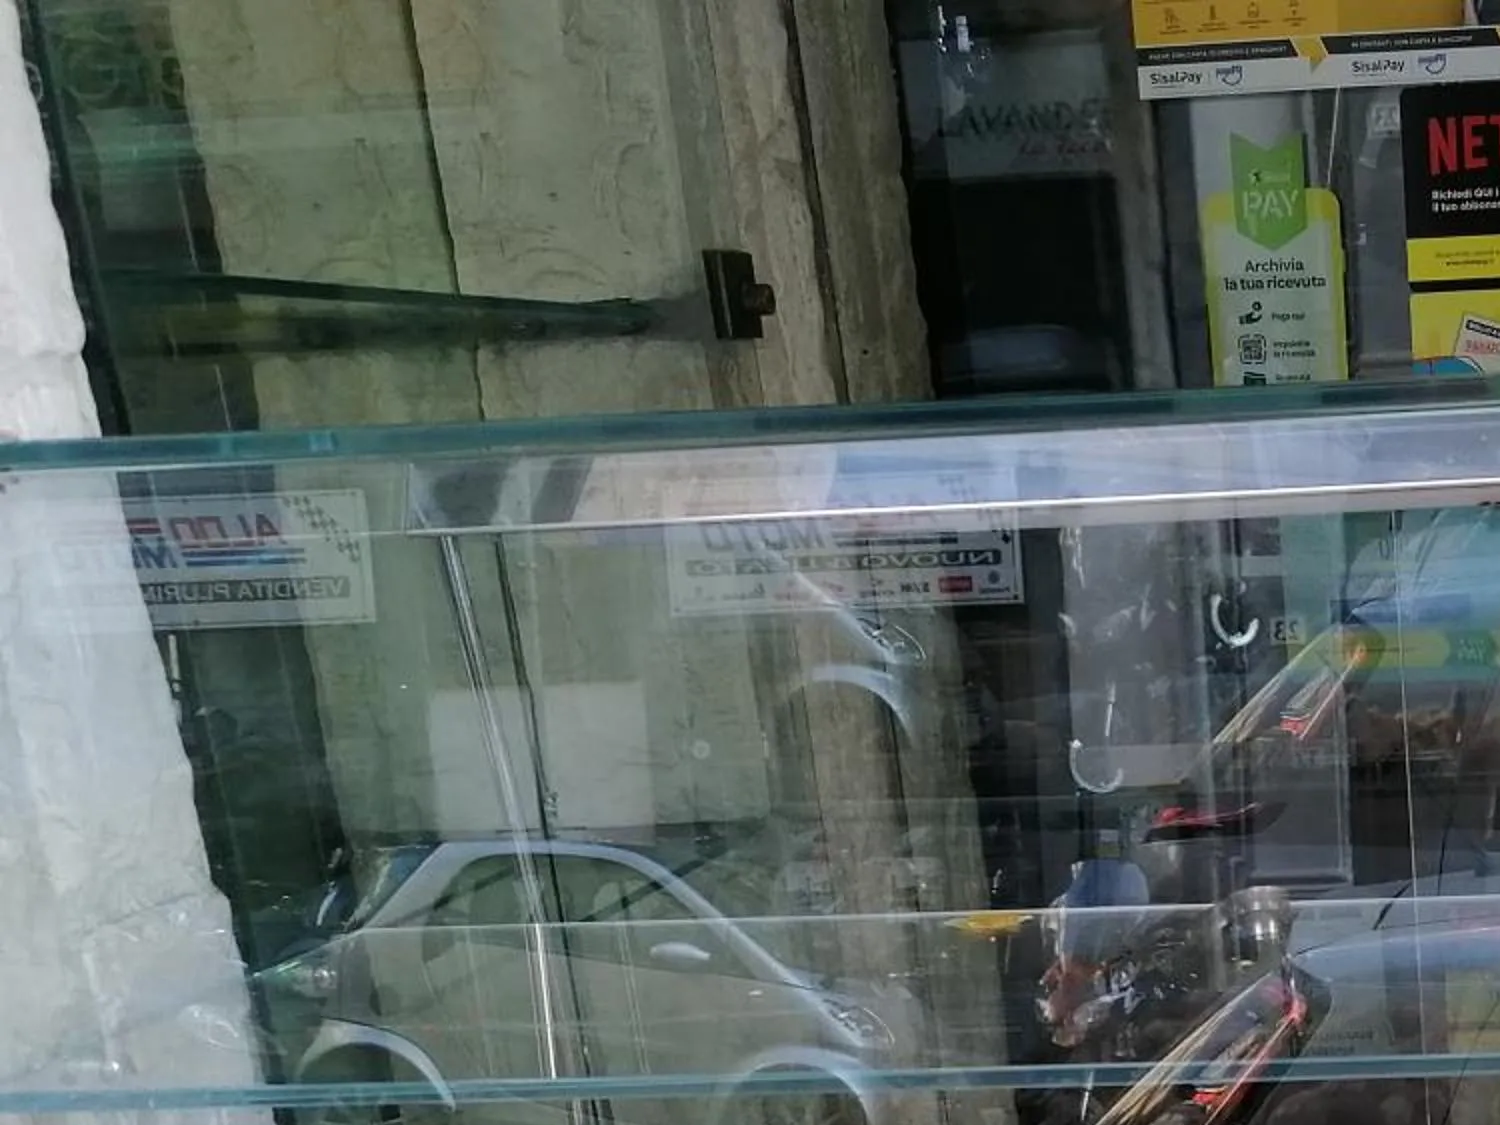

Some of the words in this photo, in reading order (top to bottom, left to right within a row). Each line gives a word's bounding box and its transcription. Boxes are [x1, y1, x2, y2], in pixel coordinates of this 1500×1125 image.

[1432, 187, 1472, 200] Richiedi
[1474, 186, 1493, 198] QUI
[1243, 190, 1298, 218] PAY
[1441, 201, 1458, 212] tuo
[1245, 258, 1304, 273] Archivia
[1224, 278, 1237, 292] la
[1239, 278, 1265, 291] tua
[1267, 276, 1326, 290] ricevuta
